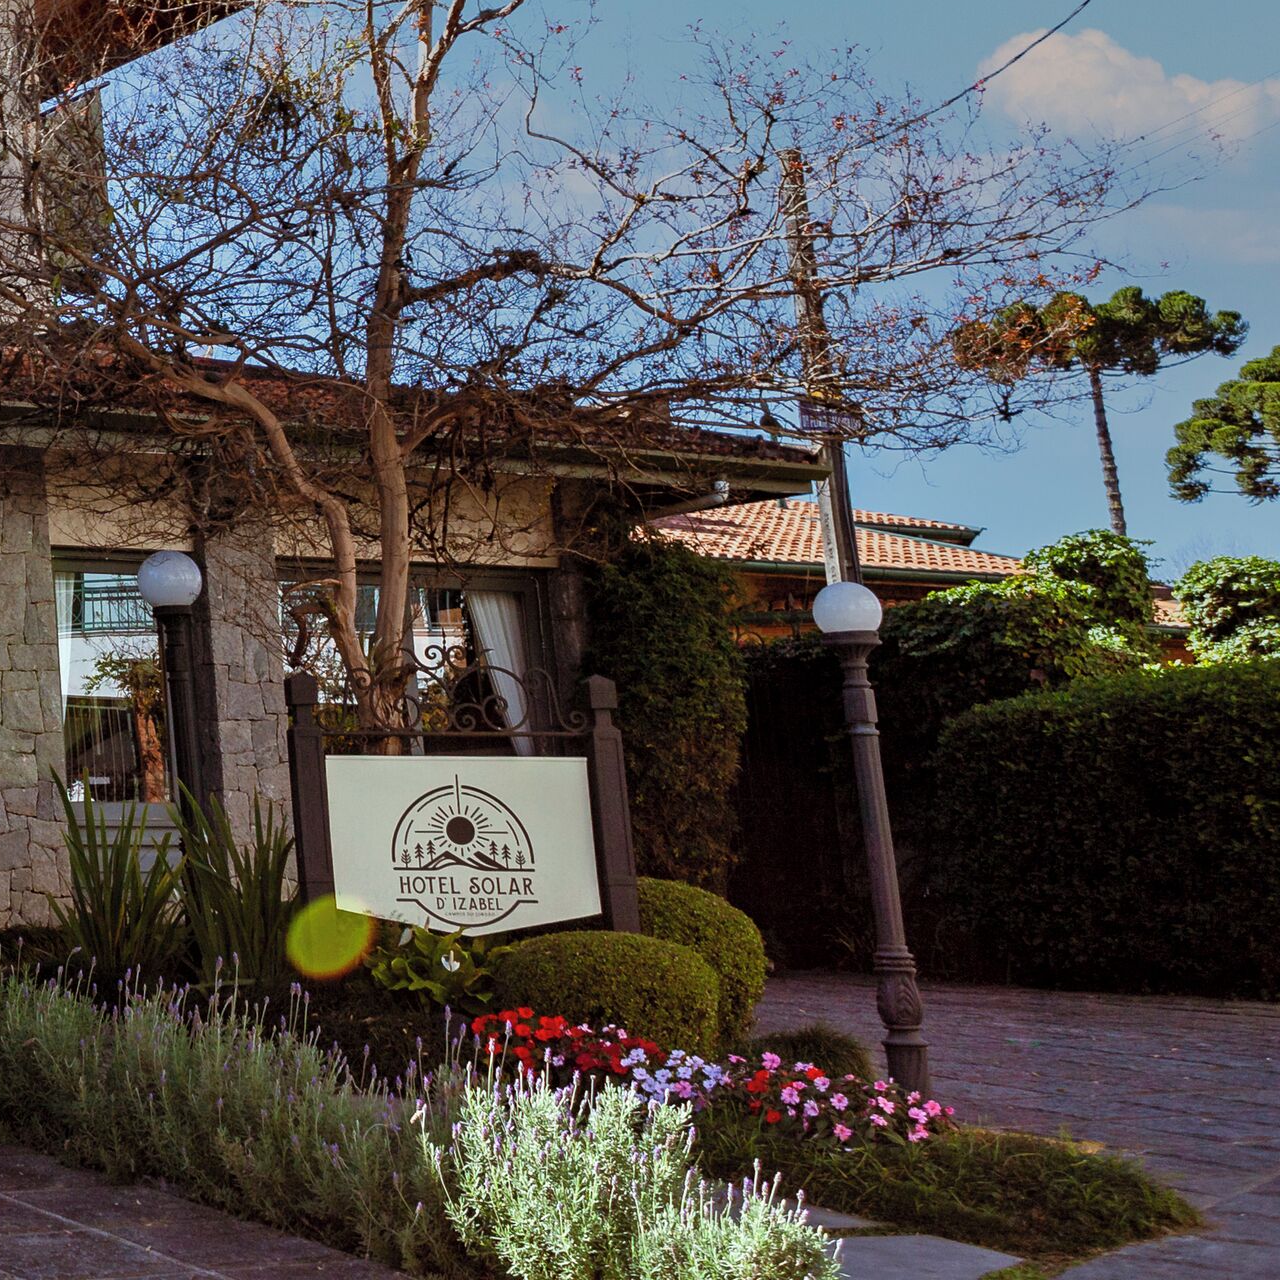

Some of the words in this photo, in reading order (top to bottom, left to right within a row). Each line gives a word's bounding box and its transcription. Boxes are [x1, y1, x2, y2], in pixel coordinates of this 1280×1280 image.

[399, 876, 461, 894] HOTEL
[469, 877, 535, 895] SOLAR
[453, 897, 504, 911] IZABEL
